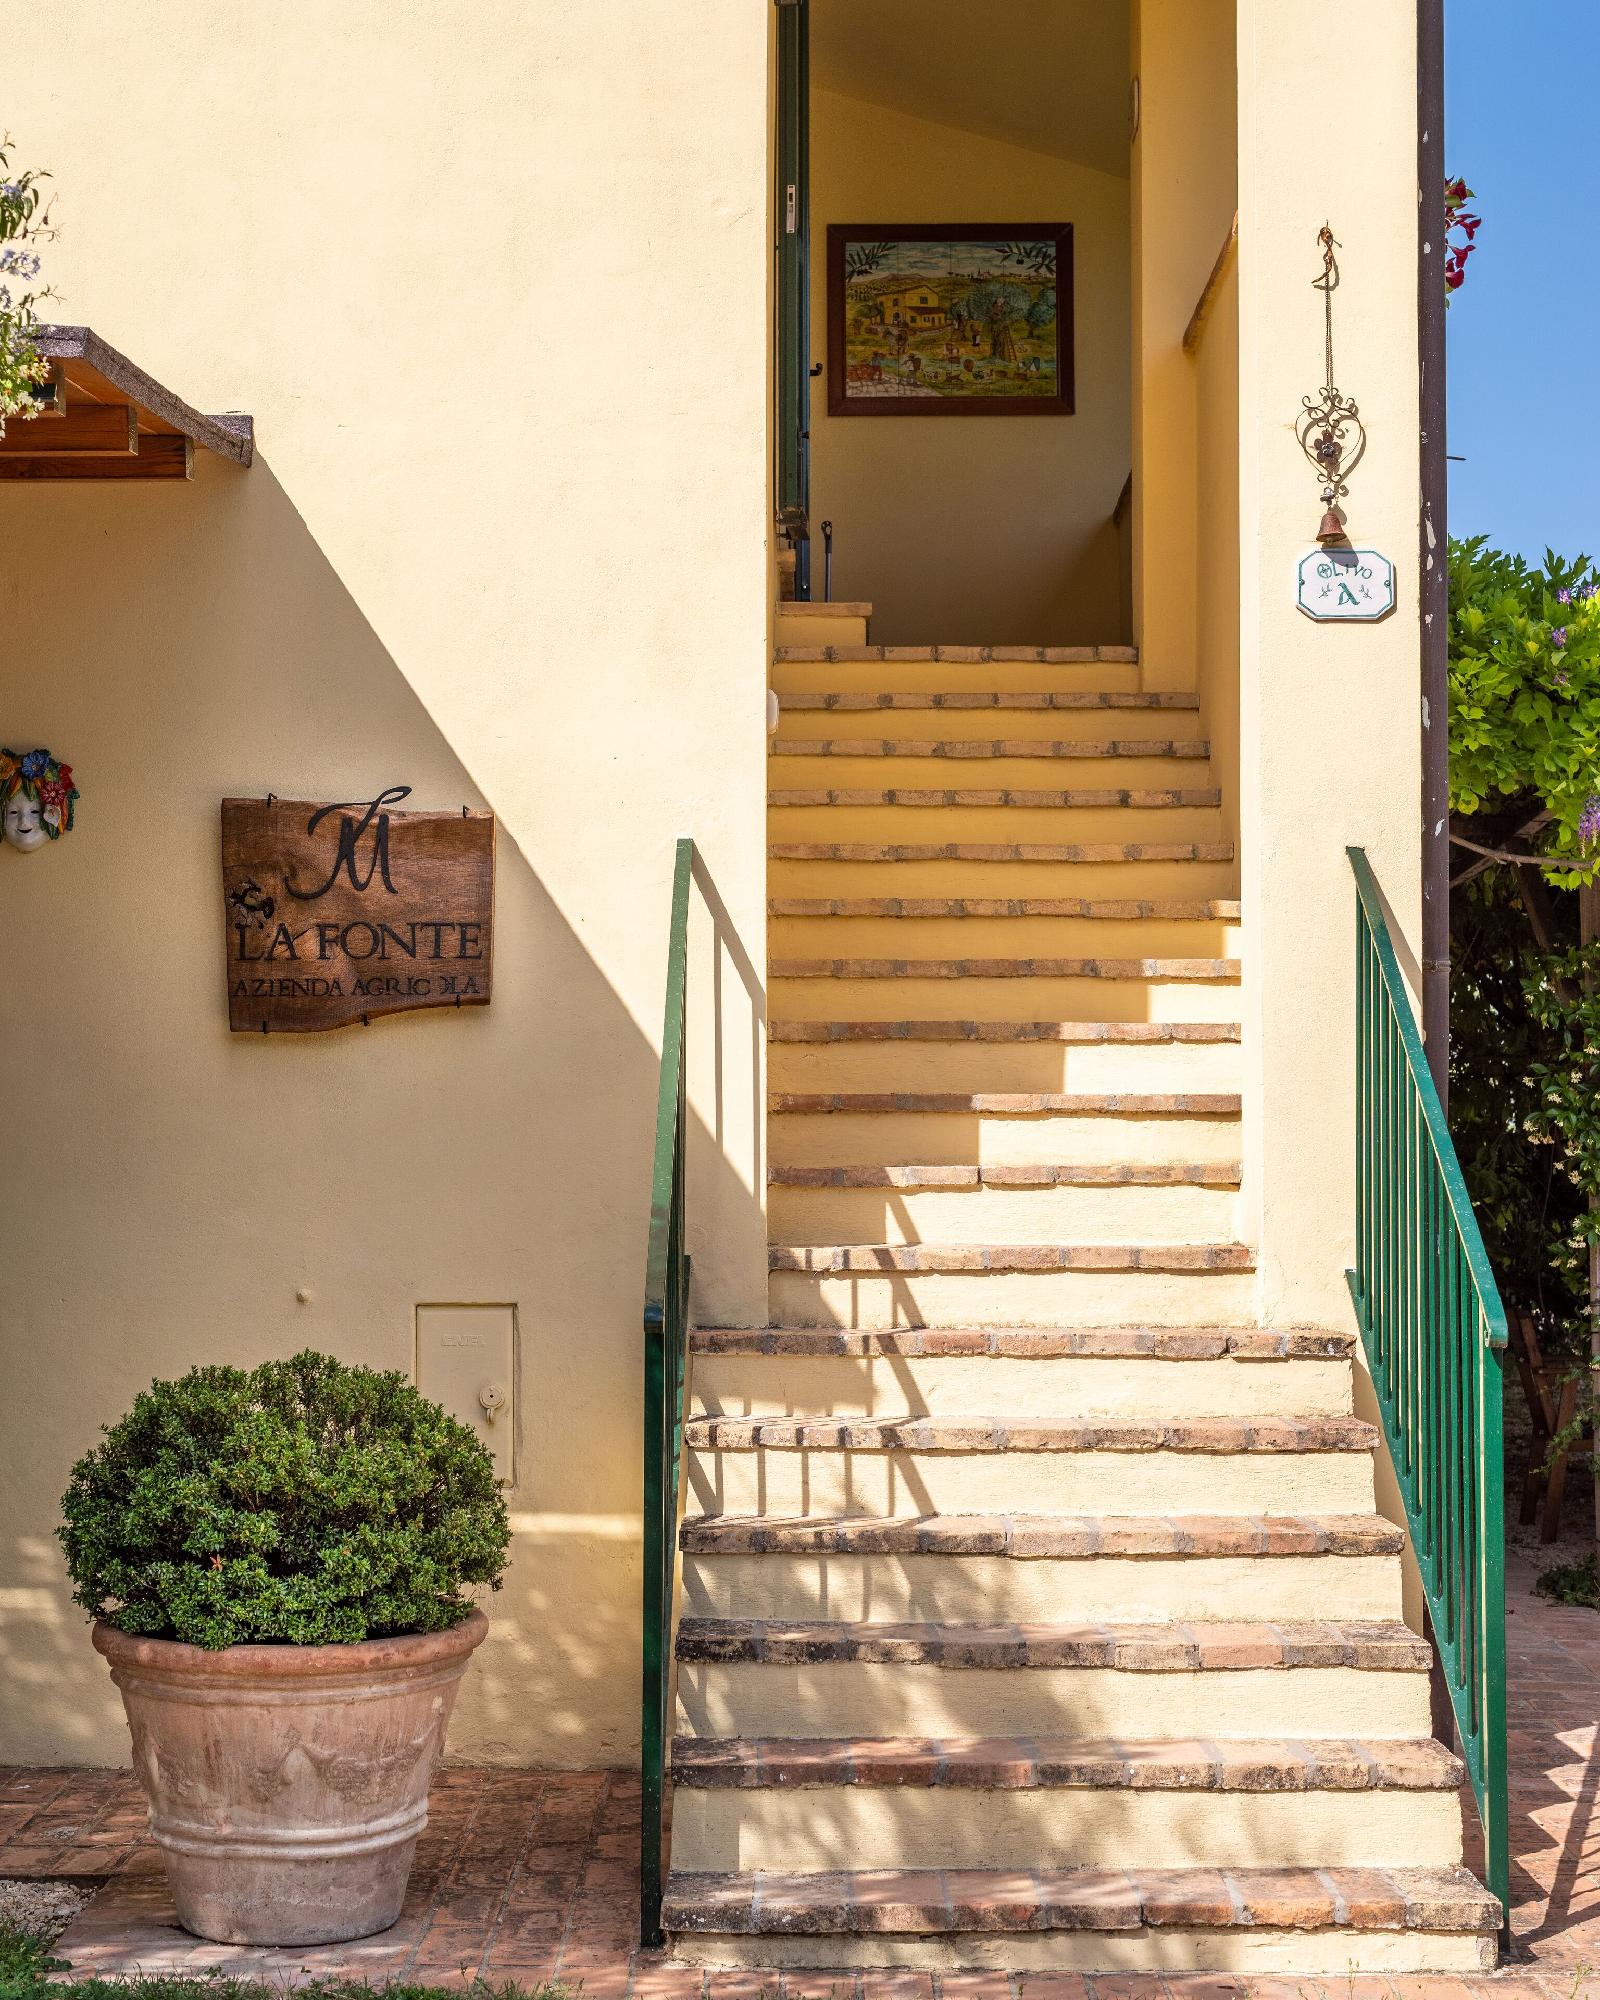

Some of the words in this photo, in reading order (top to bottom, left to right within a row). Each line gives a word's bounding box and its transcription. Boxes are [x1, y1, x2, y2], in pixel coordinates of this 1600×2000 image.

[1337, 582, 1361, 606] A
[234, 923, 301, 961] LA
[316, 921, 482, 960] FONTE
[233, 977, 345, 998] AZIENDA
